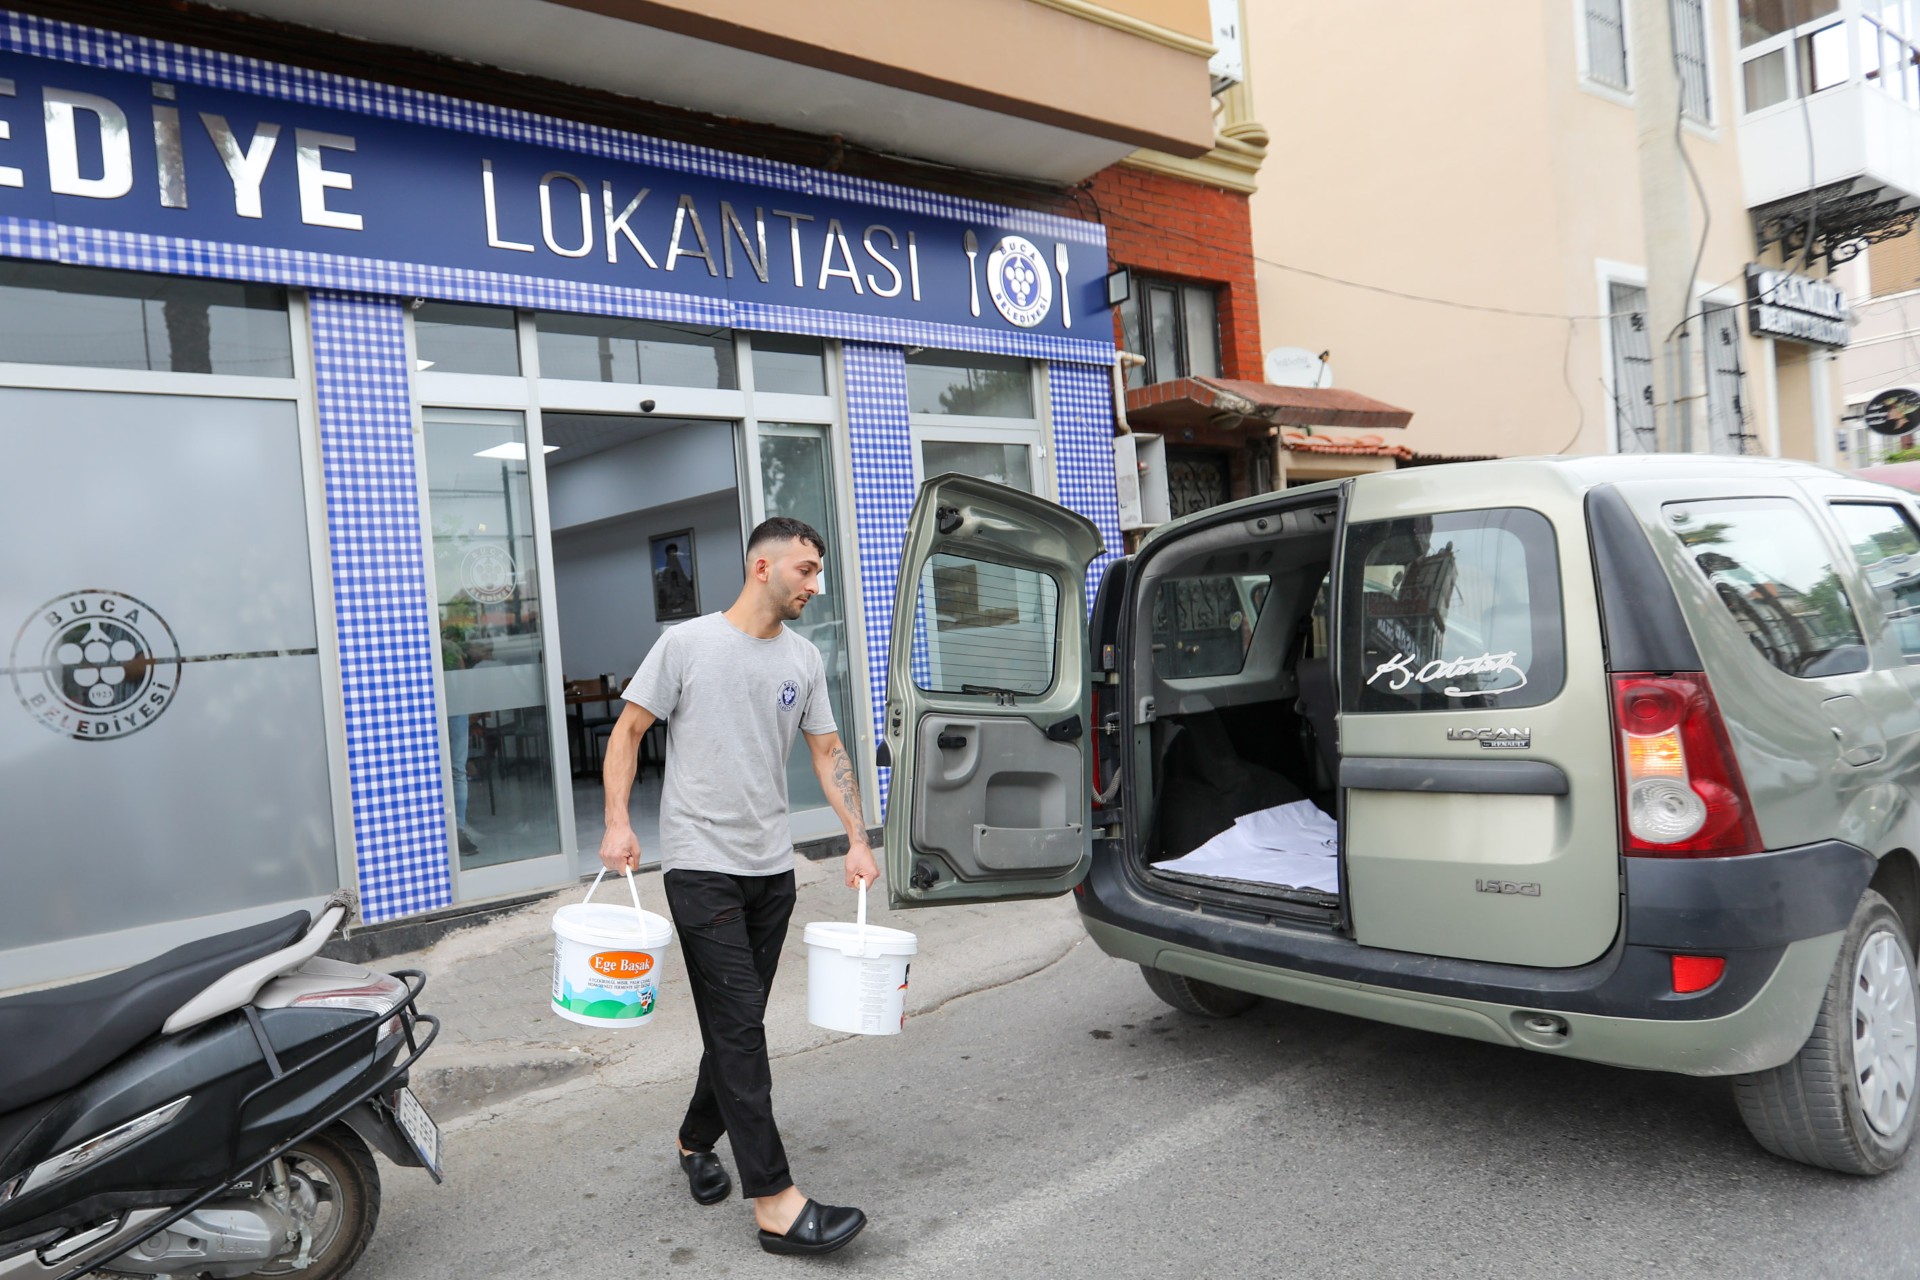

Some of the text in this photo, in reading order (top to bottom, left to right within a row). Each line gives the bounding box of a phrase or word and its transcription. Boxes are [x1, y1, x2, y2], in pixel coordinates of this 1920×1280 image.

[482, 159, 921, 301] LOKANTASI
[1000, 243, 1036, 261] BUCA
[45, 599, 139, 627] BUCA
[29, 681, 170, 735] BELEDİYESİ
[1447, 727, 1531, 741] LOGAN
[594, 956, 651, 974] Ege Başak
